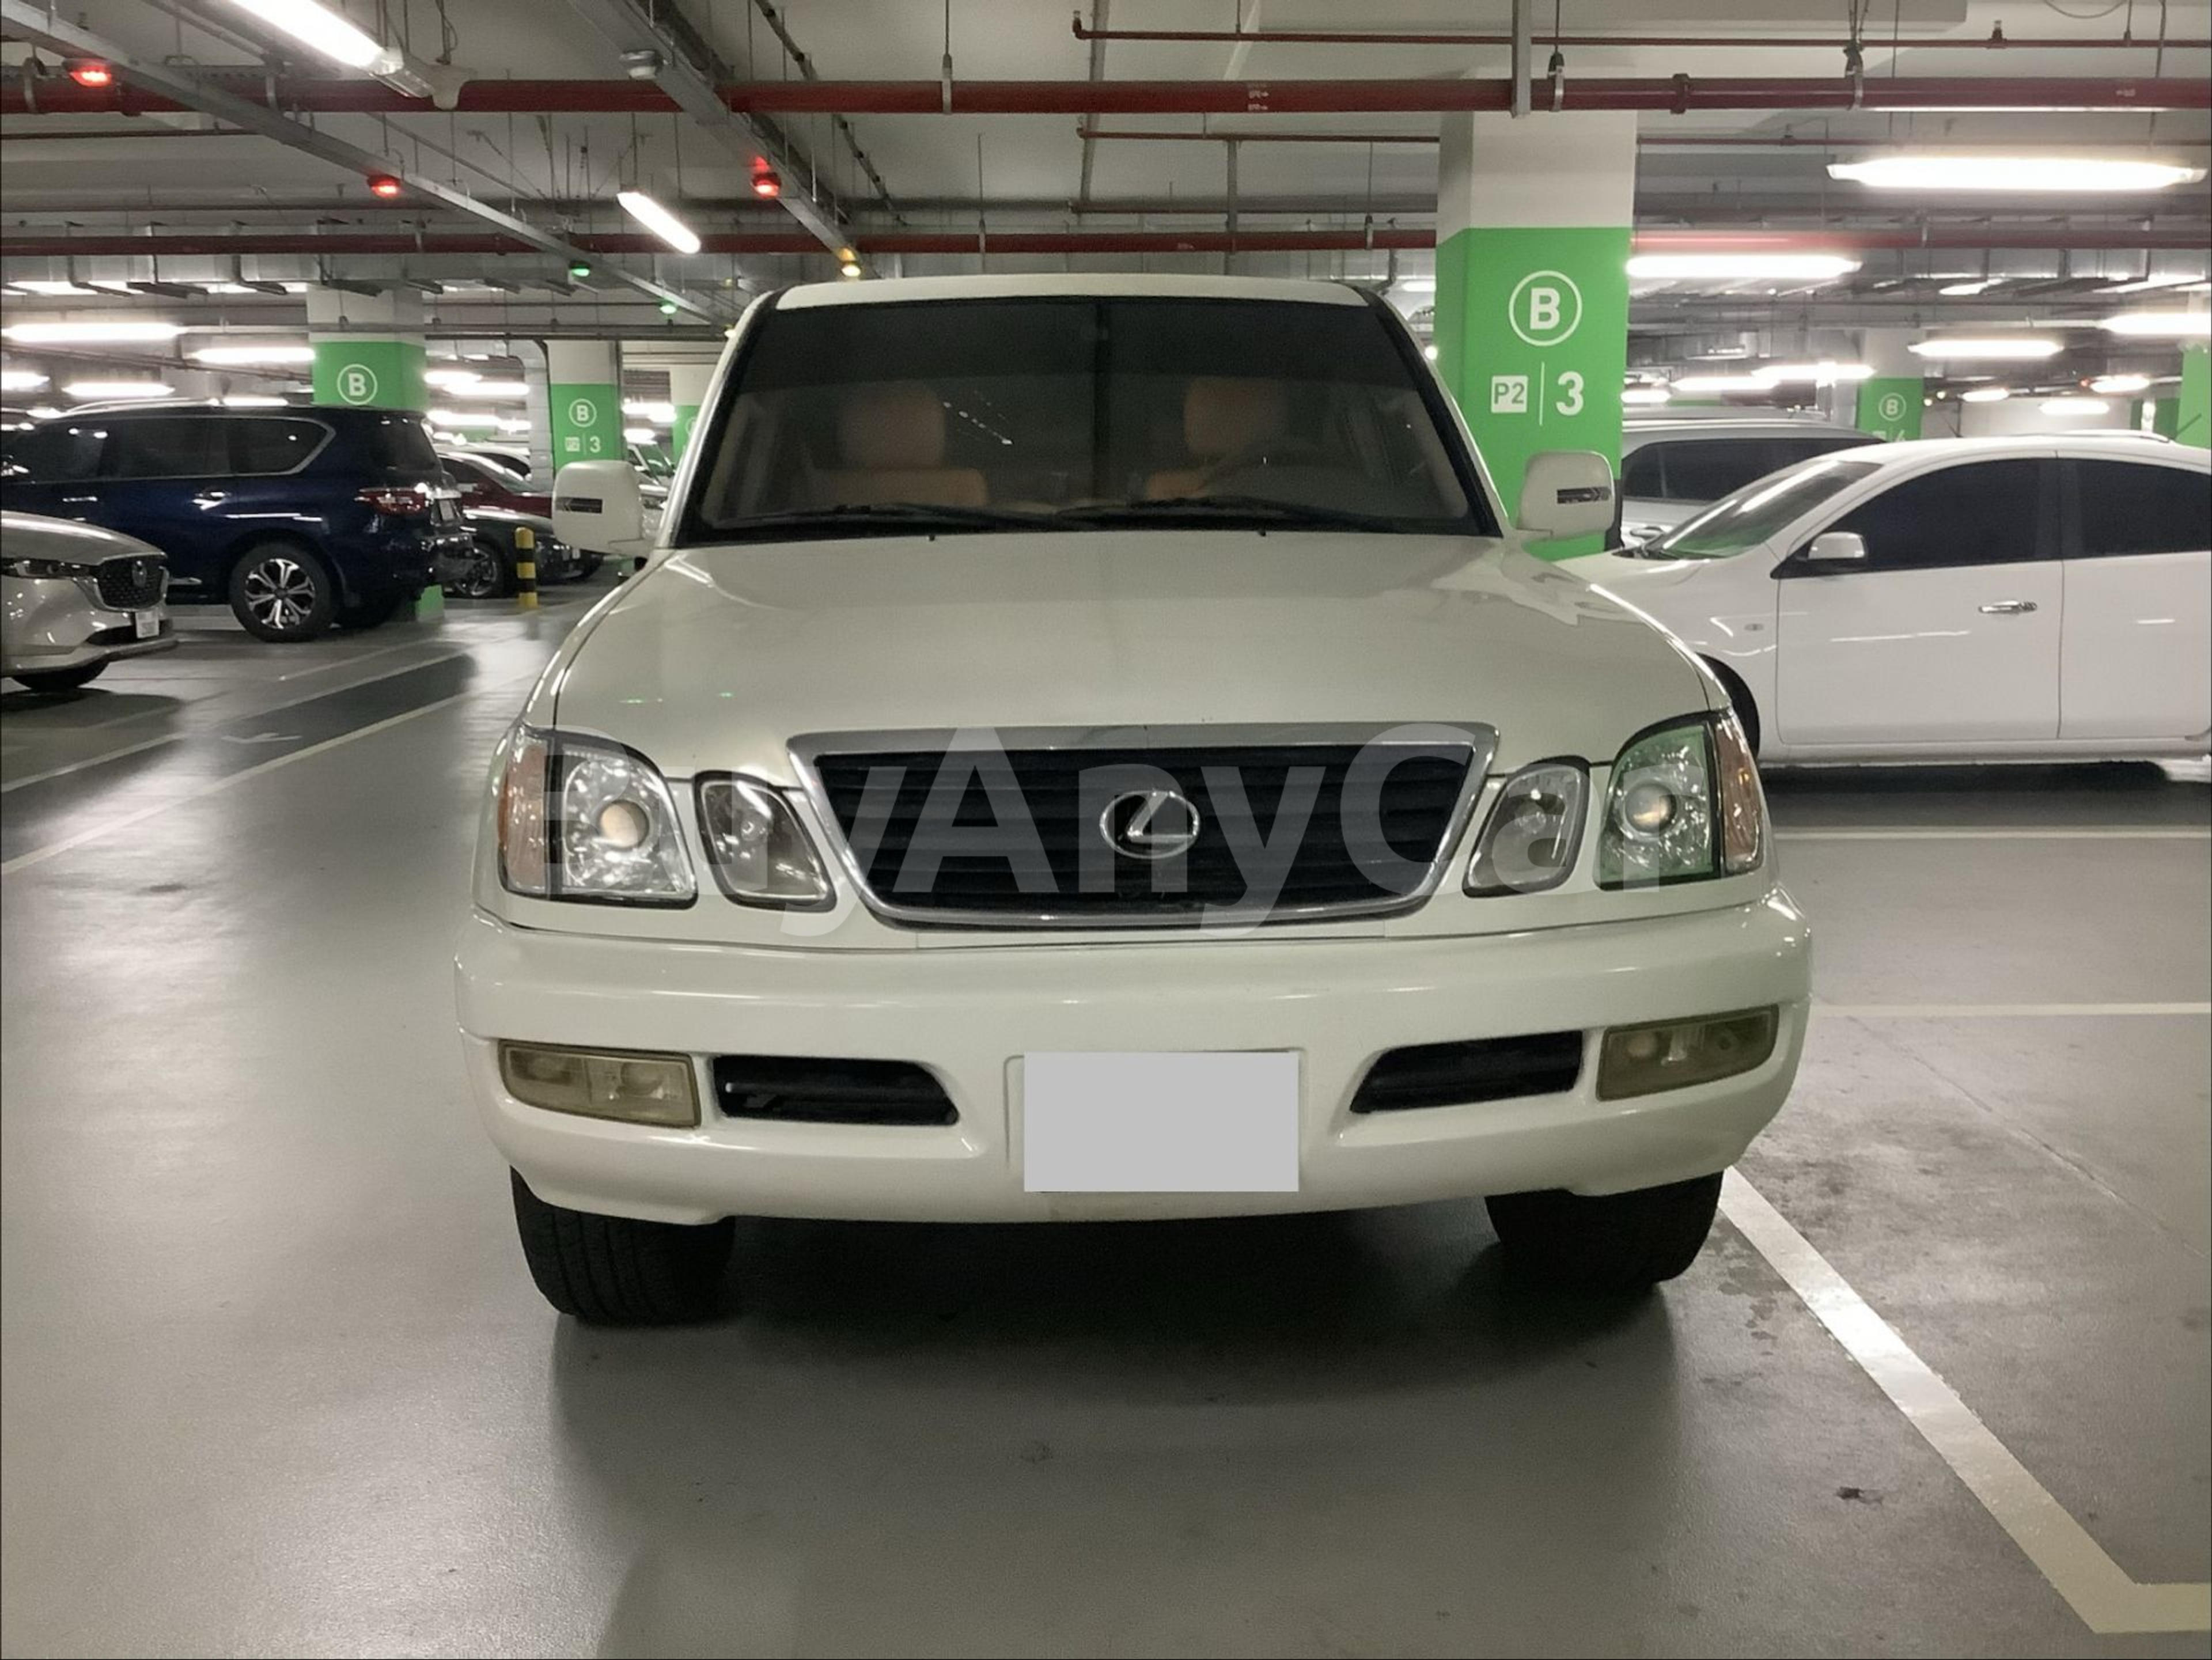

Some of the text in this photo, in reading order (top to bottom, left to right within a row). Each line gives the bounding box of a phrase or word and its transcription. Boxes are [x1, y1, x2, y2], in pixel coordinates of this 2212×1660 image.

[1530, 287, 1560, 330] B
[349, 373, 366, 396] B
[1494, 372, 1584, 416] P2 3
[577, 405, 589, 421] B
[1887, 399, 1898, 415] B
[589, 436, 601, 453] 3
